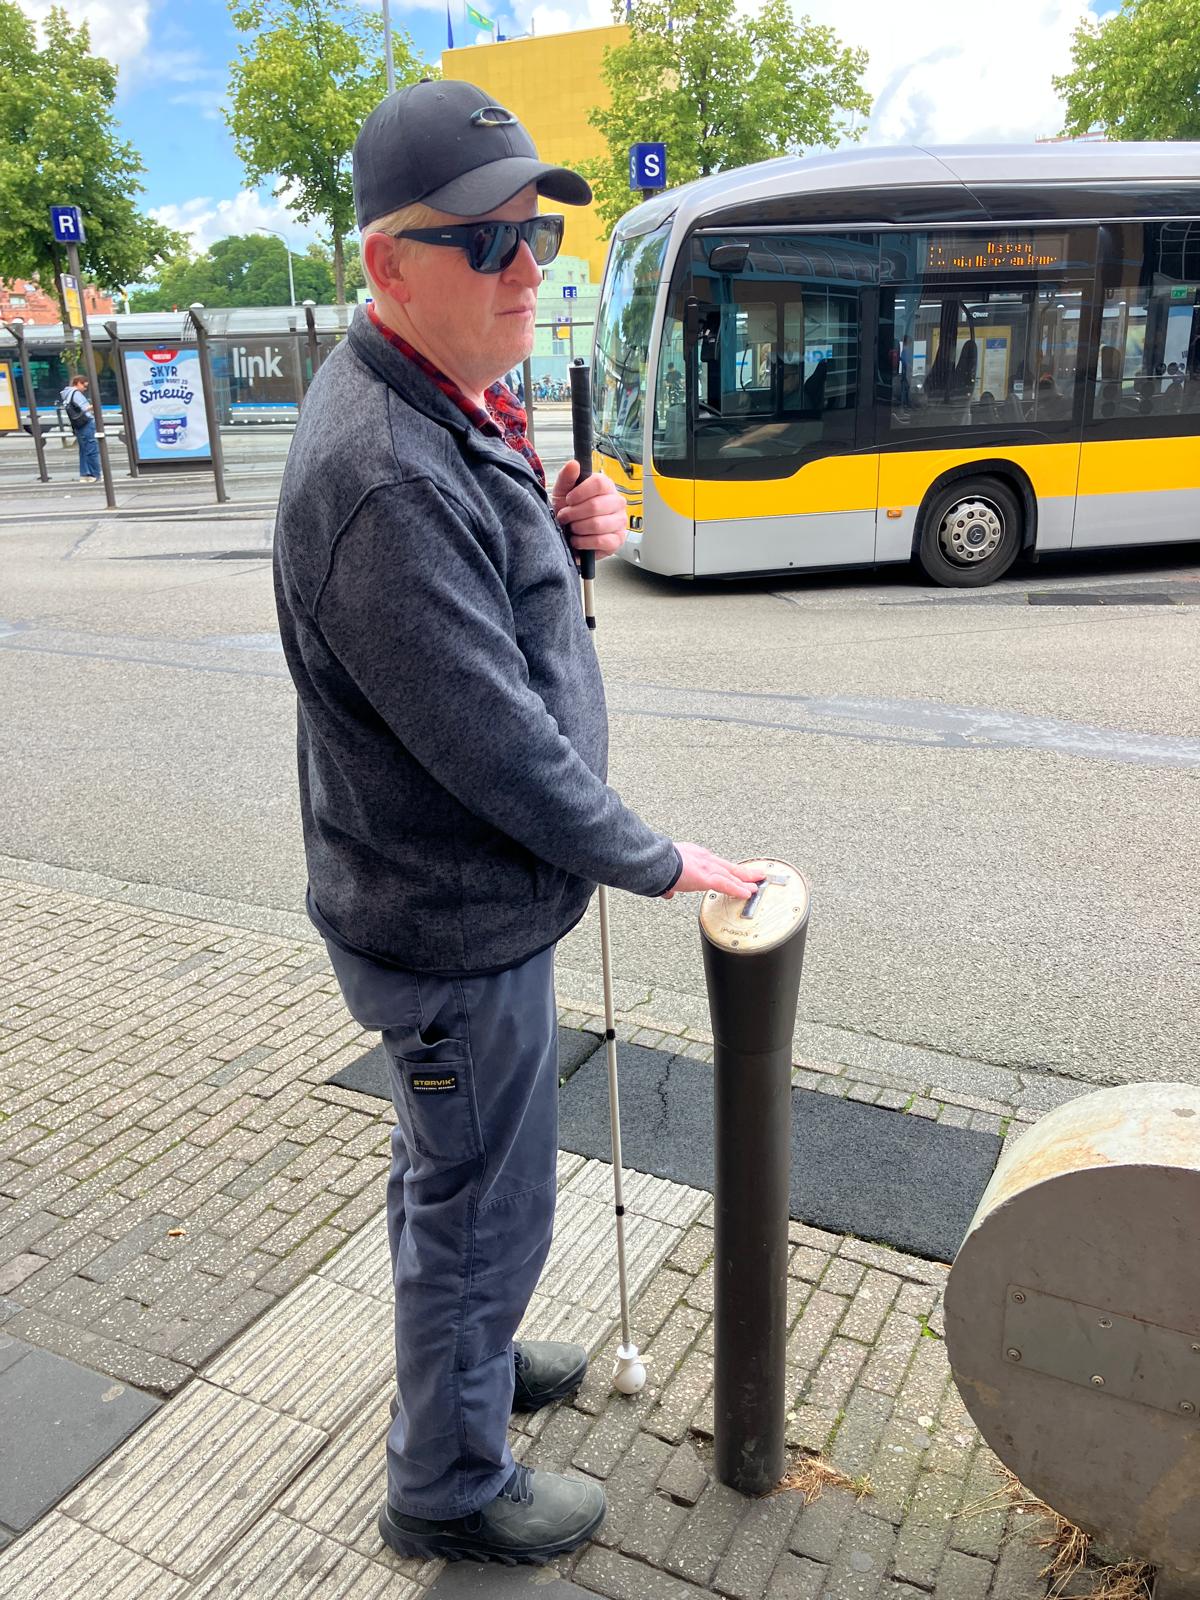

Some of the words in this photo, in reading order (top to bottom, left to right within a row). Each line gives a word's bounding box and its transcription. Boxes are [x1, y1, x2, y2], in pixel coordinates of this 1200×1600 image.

[644, 153, 660, 177] S
[58, 215, 75, 233] R
[564, 289, 571, 298] E
[149, 366, 178, 377] SKYR
[232, 346, 284, 386] link
